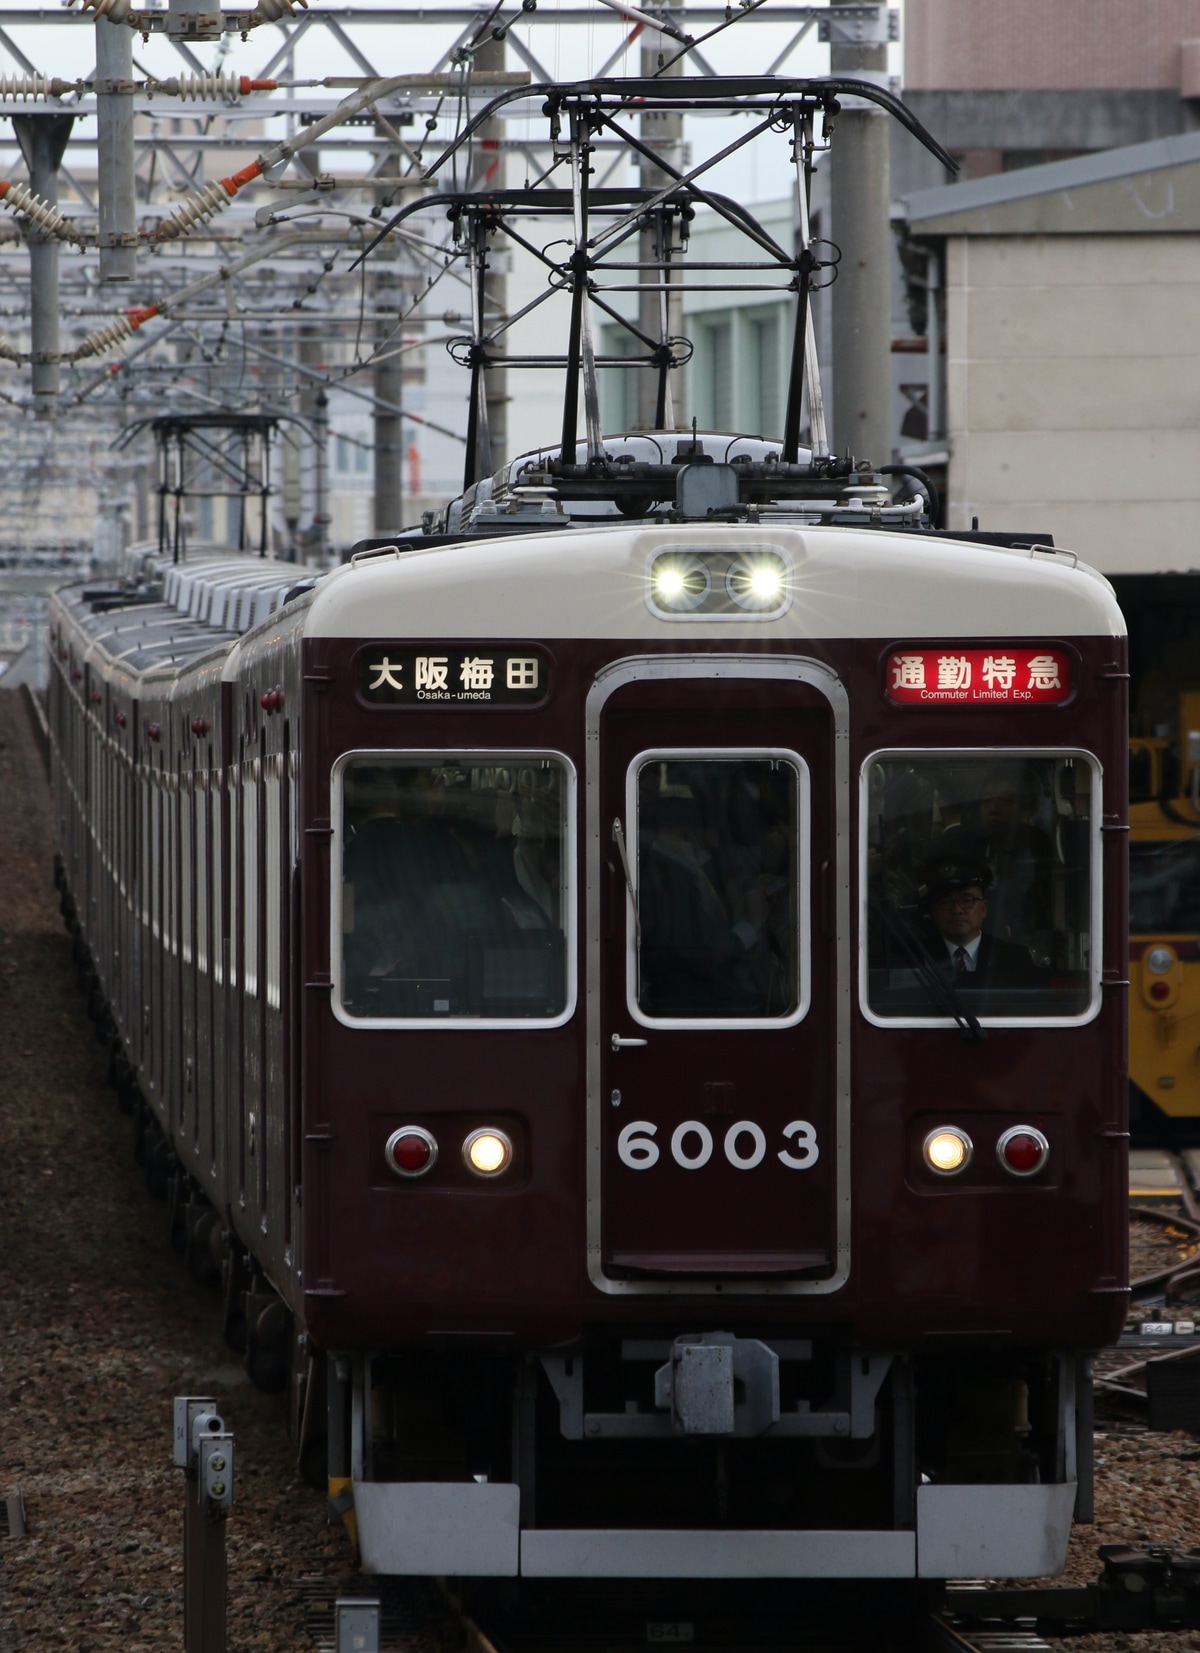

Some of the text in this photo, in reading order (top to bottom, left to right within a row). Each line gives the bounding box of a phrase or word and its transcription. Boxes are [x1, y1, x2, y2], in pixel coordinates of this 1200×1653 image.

[369, 656, 539, 690] 大阪梅田
[892, 655, 1061, 690] 通勤特急
[417, 690, 491, 700] Osaka-umeda
[920, 690, 1034, 700] Commuter Limited Exp.
[617, 1120, 820, 1170] 6003
